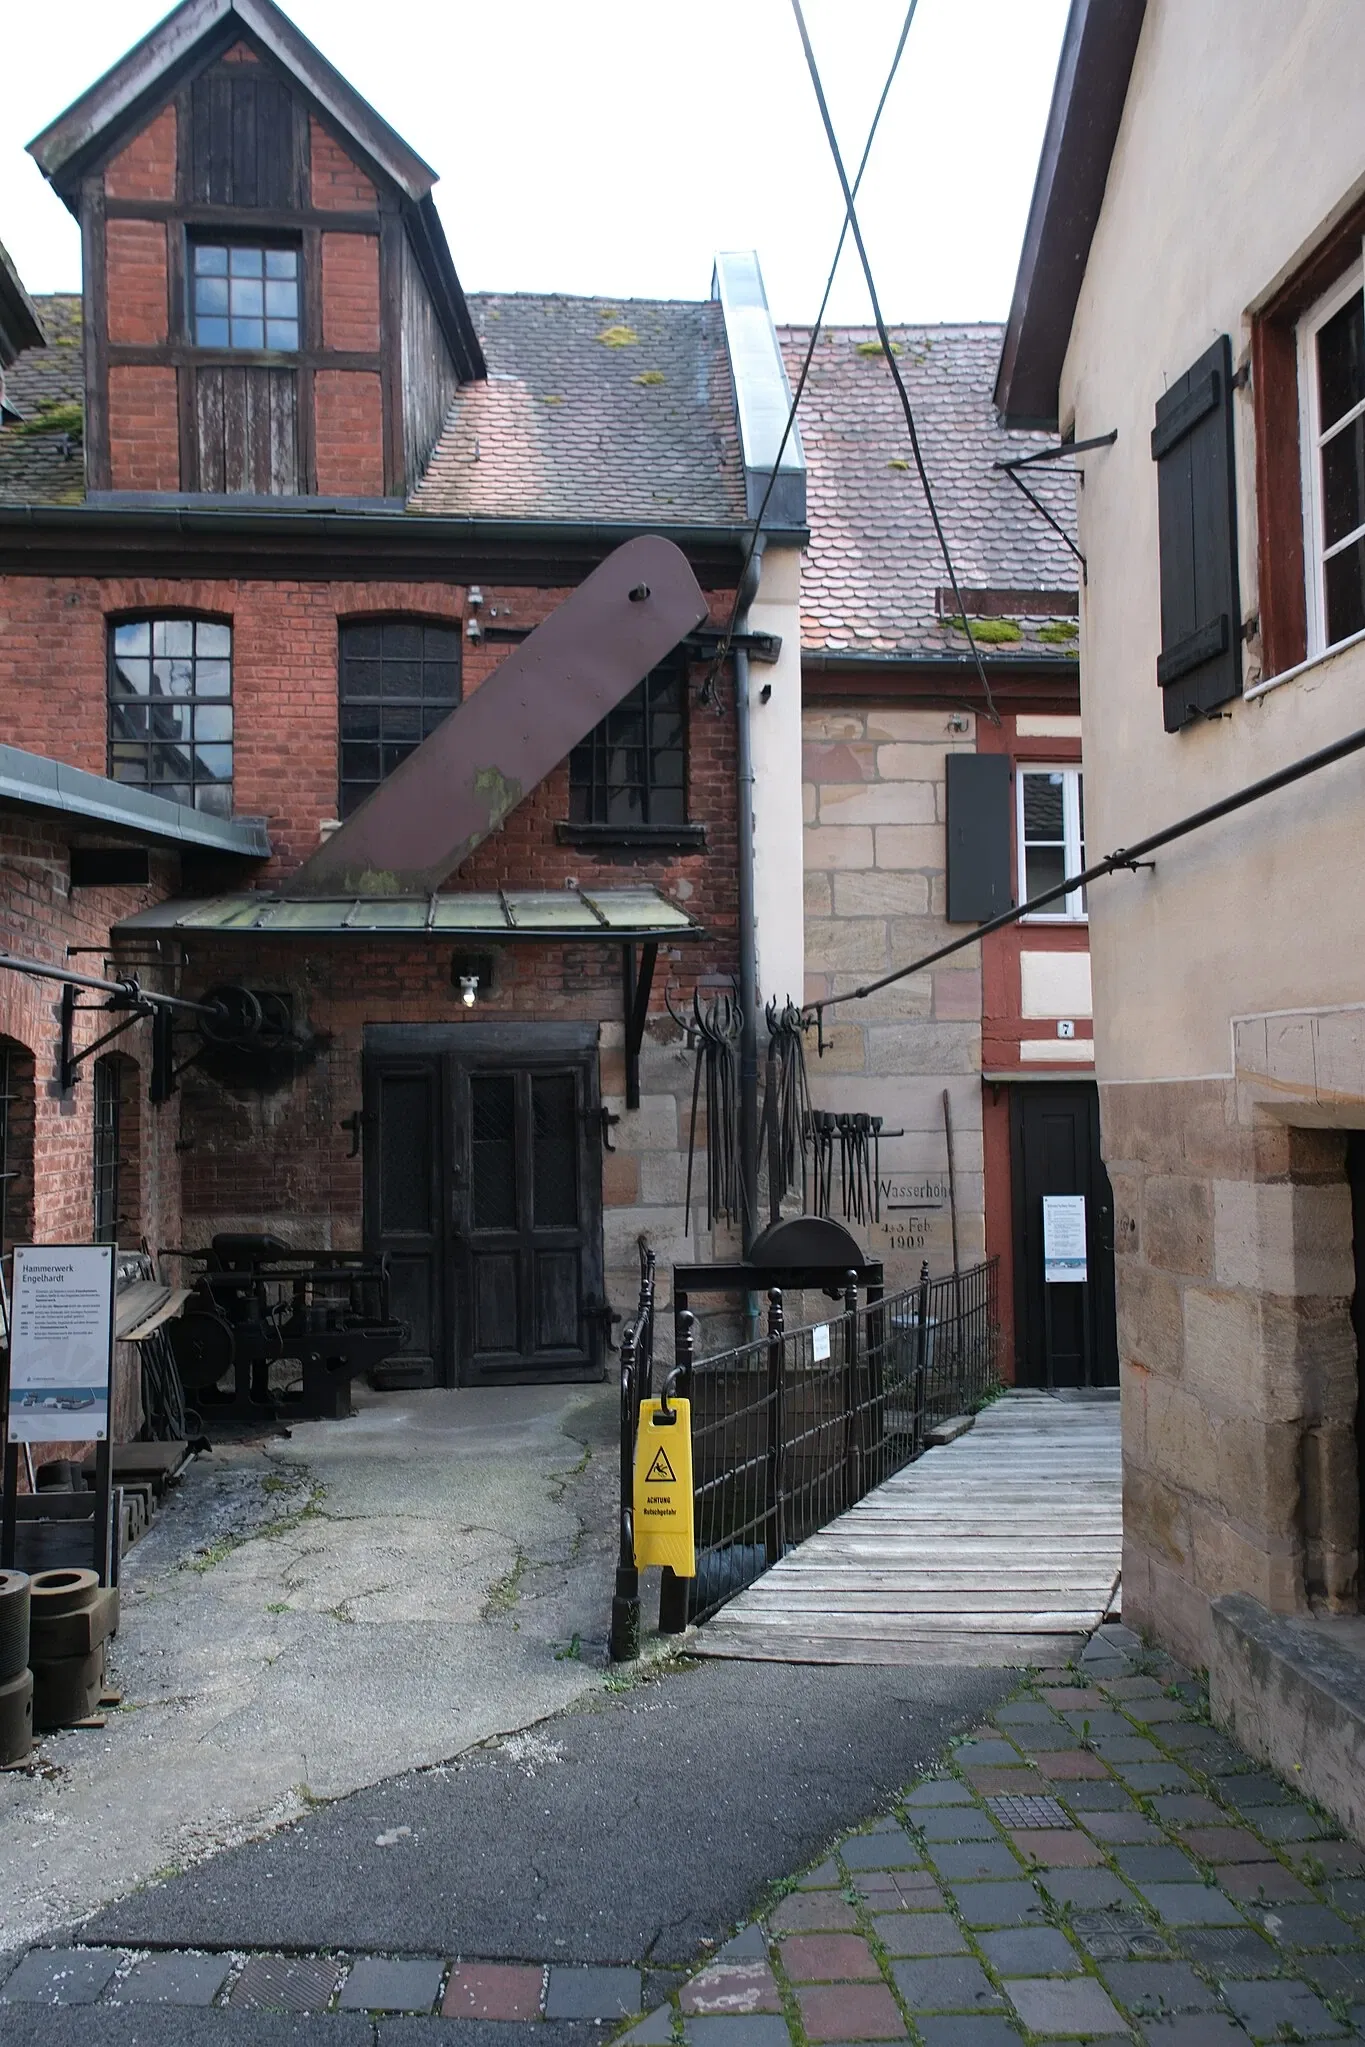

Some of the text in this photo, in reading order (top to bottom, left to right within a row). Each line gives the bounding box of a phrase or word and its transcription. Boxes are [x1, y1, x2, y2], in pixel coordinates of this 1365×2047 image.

[1062, 1023, 1070, 1035] 7
[873, 1179, 954, 1198] Wasserhöh
[889, 1235, 925, 1249] 1909
[22, 1264, 74, 1273] Hammerwerk
[22, 1274, 64, 1284] Engelhardt
[647, 1496, 671, 1504] ACHTUNG
